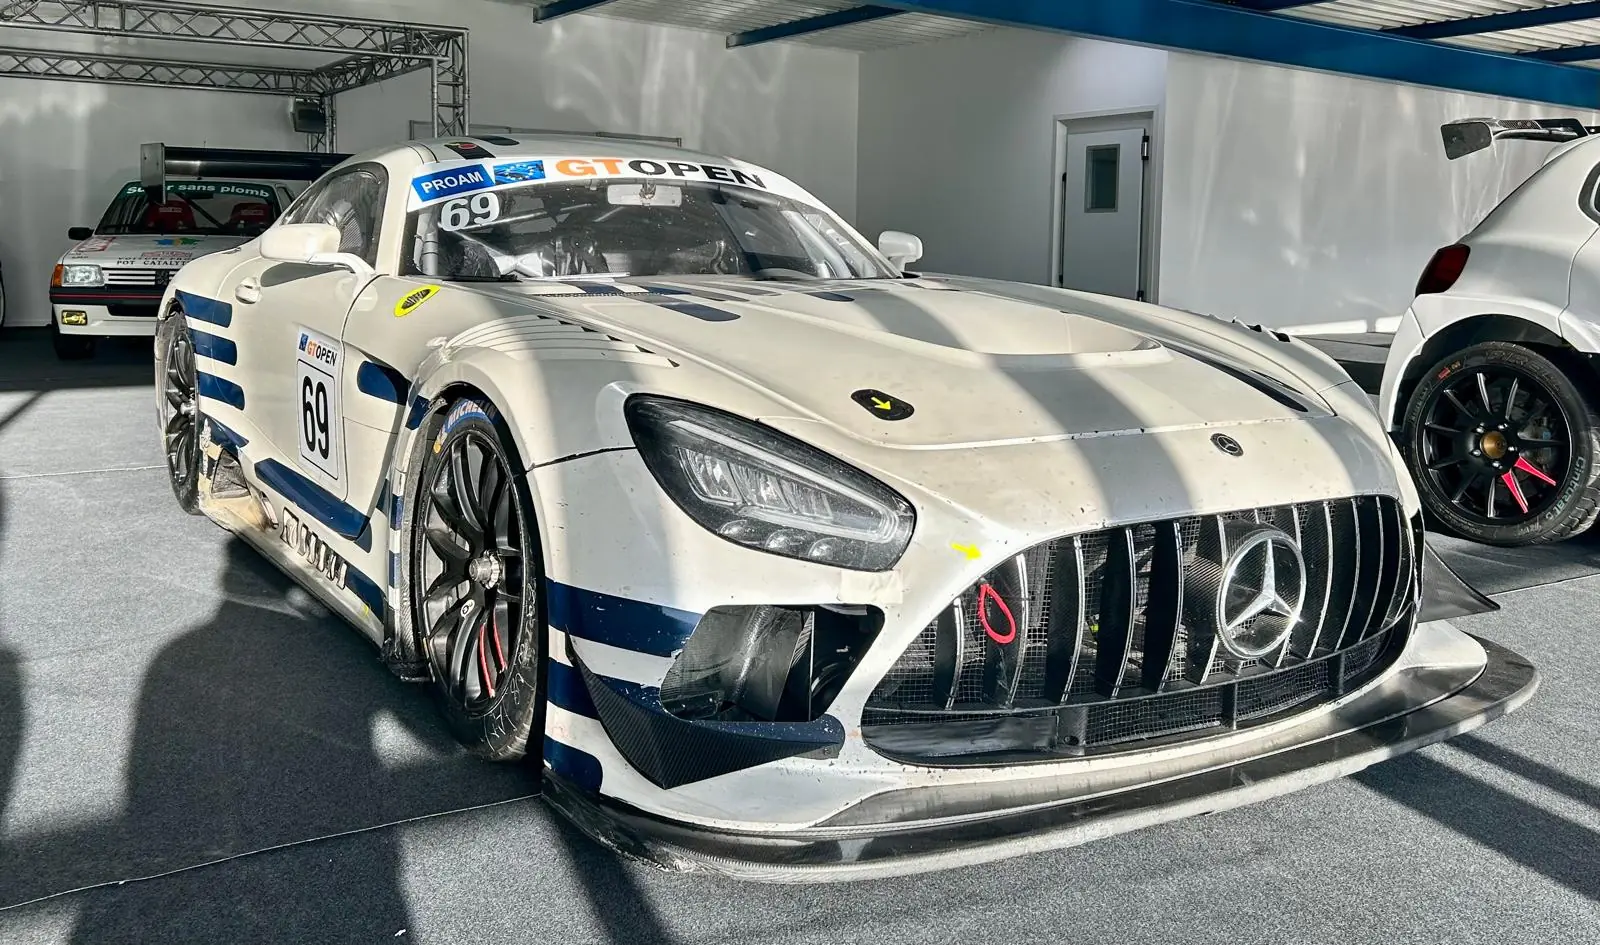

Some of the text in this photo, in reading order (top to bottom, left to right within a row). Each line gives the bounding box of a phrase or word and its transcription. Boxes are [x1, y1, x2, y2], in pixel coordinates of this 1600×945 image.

[126, 184, 174, 194] Sur
[220, 185, 270, 198] plomb
[420, 171, 484, 194] PROAM
[441, 192, 500, 231] 69
[302, 375, 330, 460] 69
